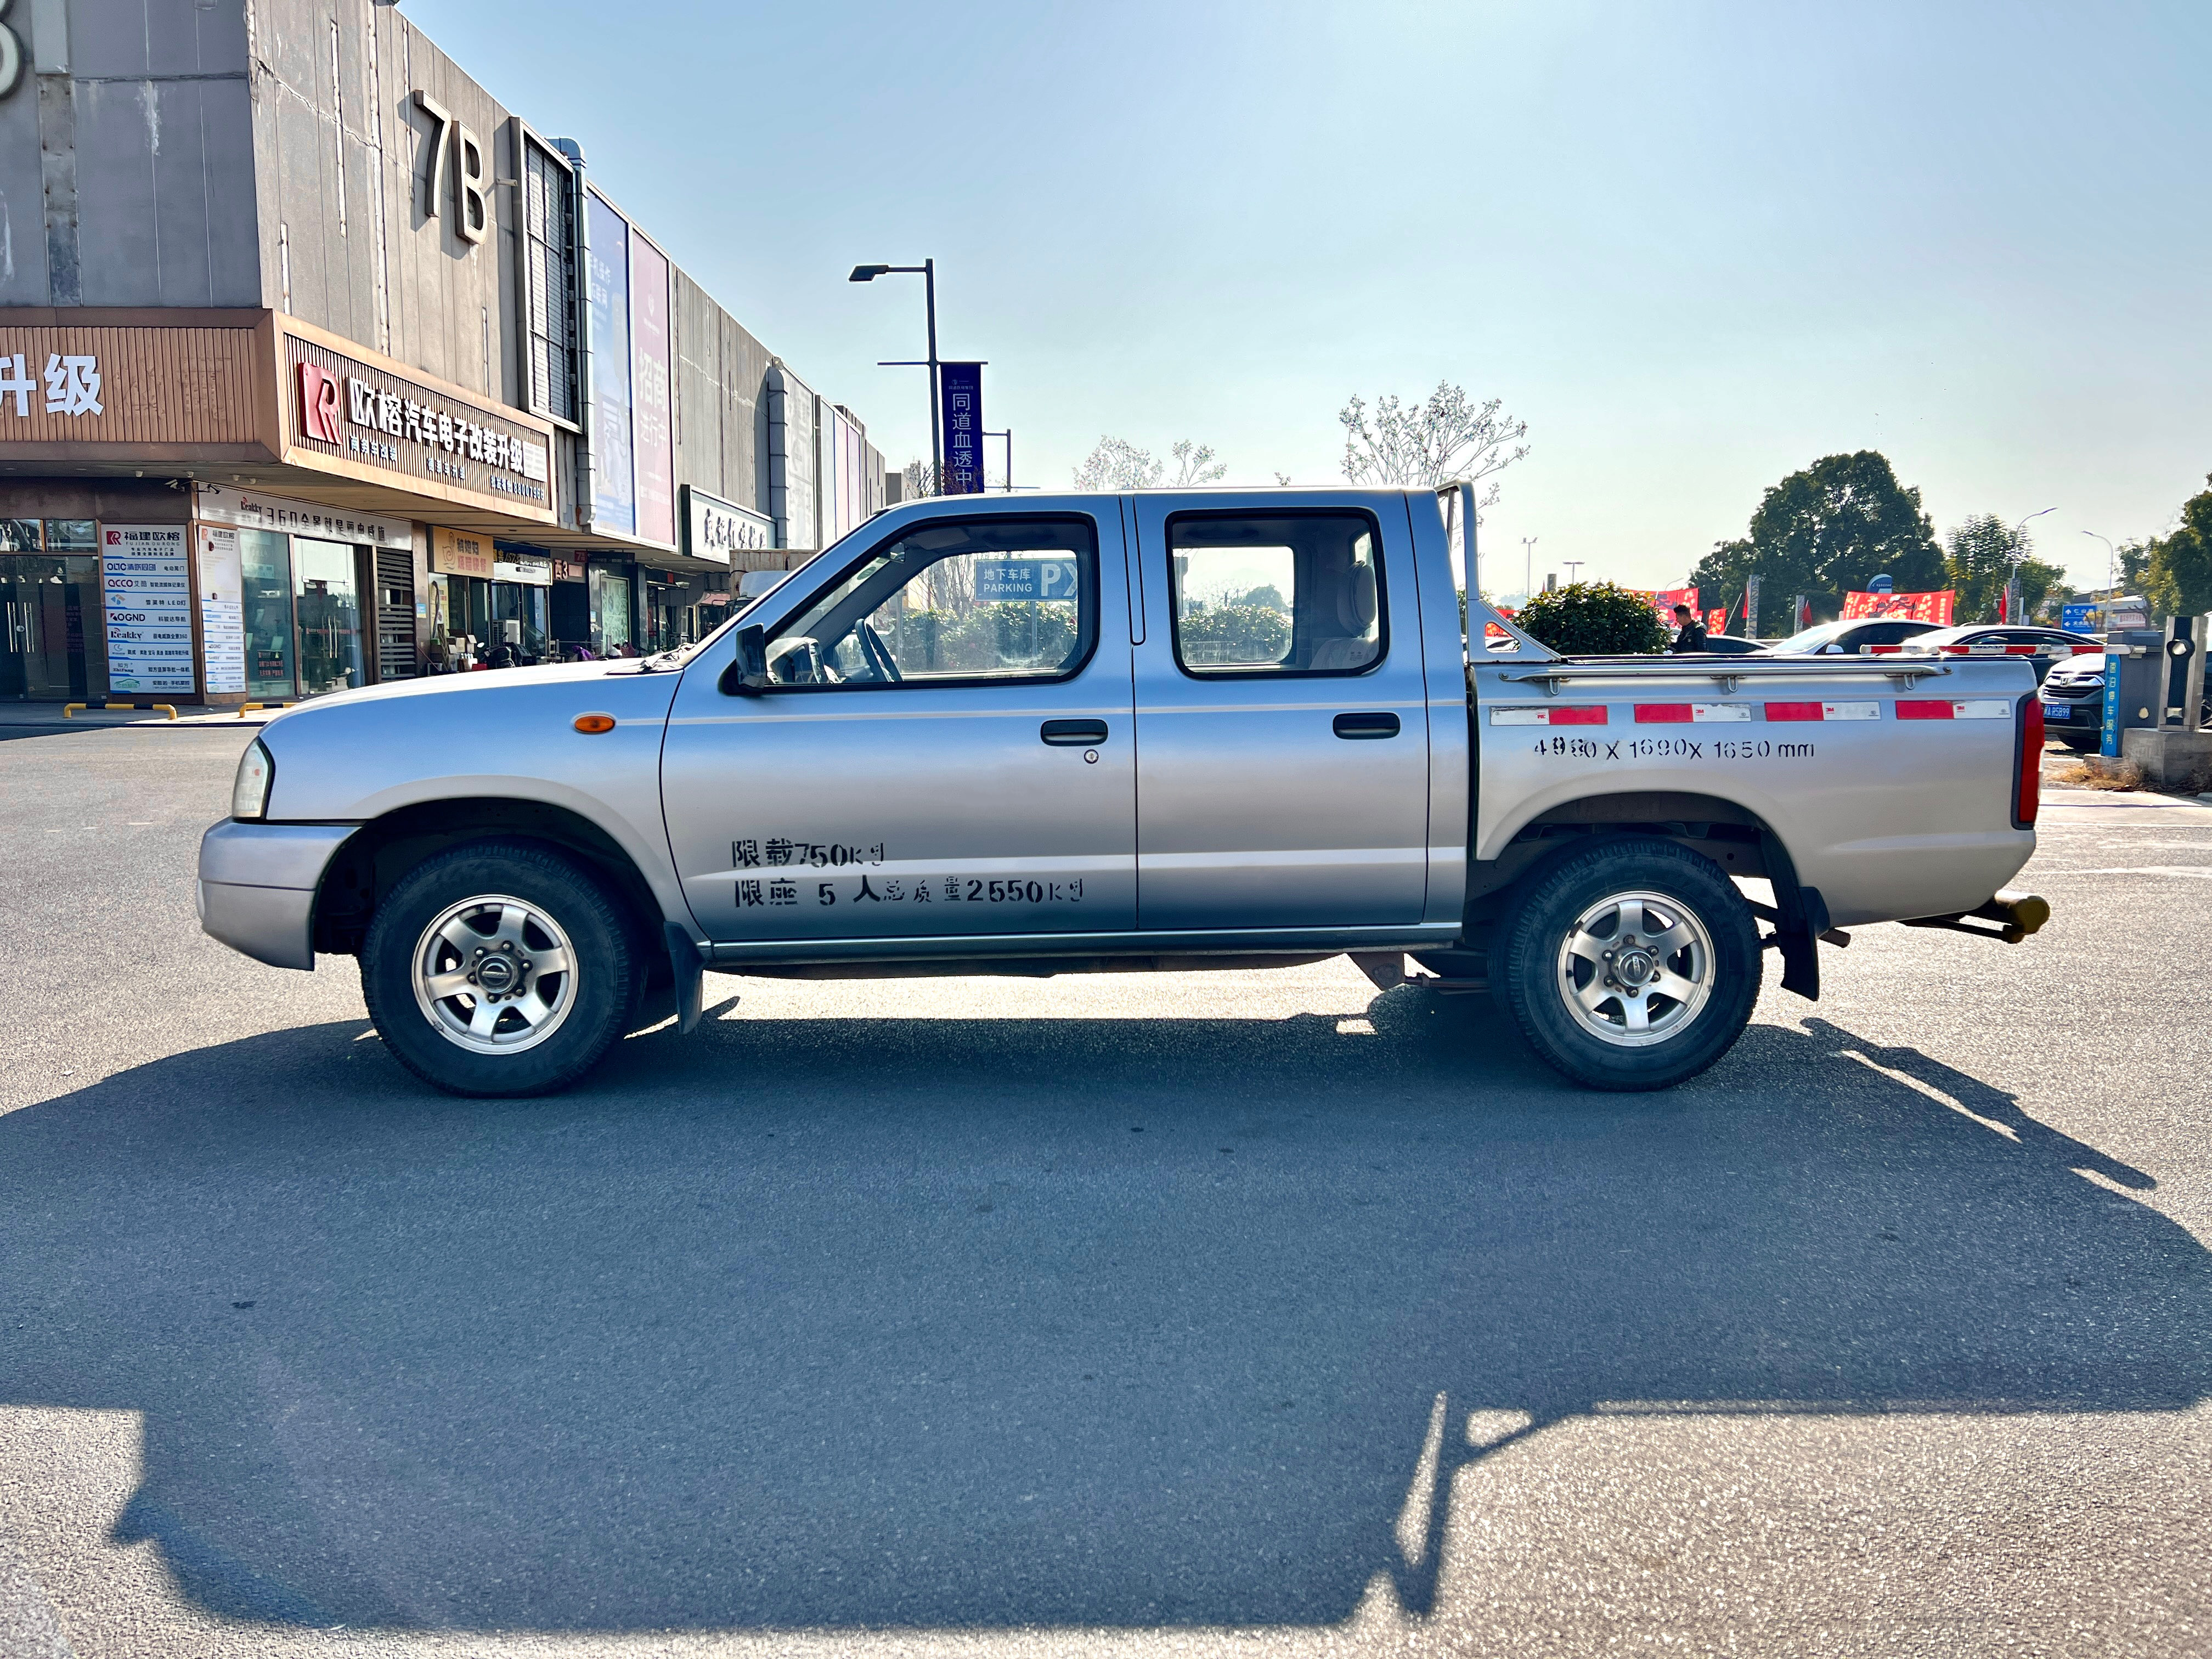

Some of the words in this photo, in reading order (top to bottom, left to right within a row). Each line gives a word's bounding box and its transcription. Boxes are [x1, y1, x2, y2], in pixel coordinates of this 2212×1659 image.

[414, 89, 487, 245] 7B
[0, 353, 104, 417] 升级
[639, 347, 666, 411] 招商
[348, 377, 524, 473] 欧榕汽车电子改装升级
[640, 408, 667, 450] 进行中
[952, 393, 973, 487] 同道血透中
[350, 436, 396, 462] 商务车改装
[124, 532, 180, 540] 福建欧榕
[984, 568, 1031, 581] 地下车库
[984, 583, 1032, 592] PARKING
[1041, 563, 1061, 596] P
[1714, 740, 1770, 759] 1650
[1778, 744, 1814, 757] mm
